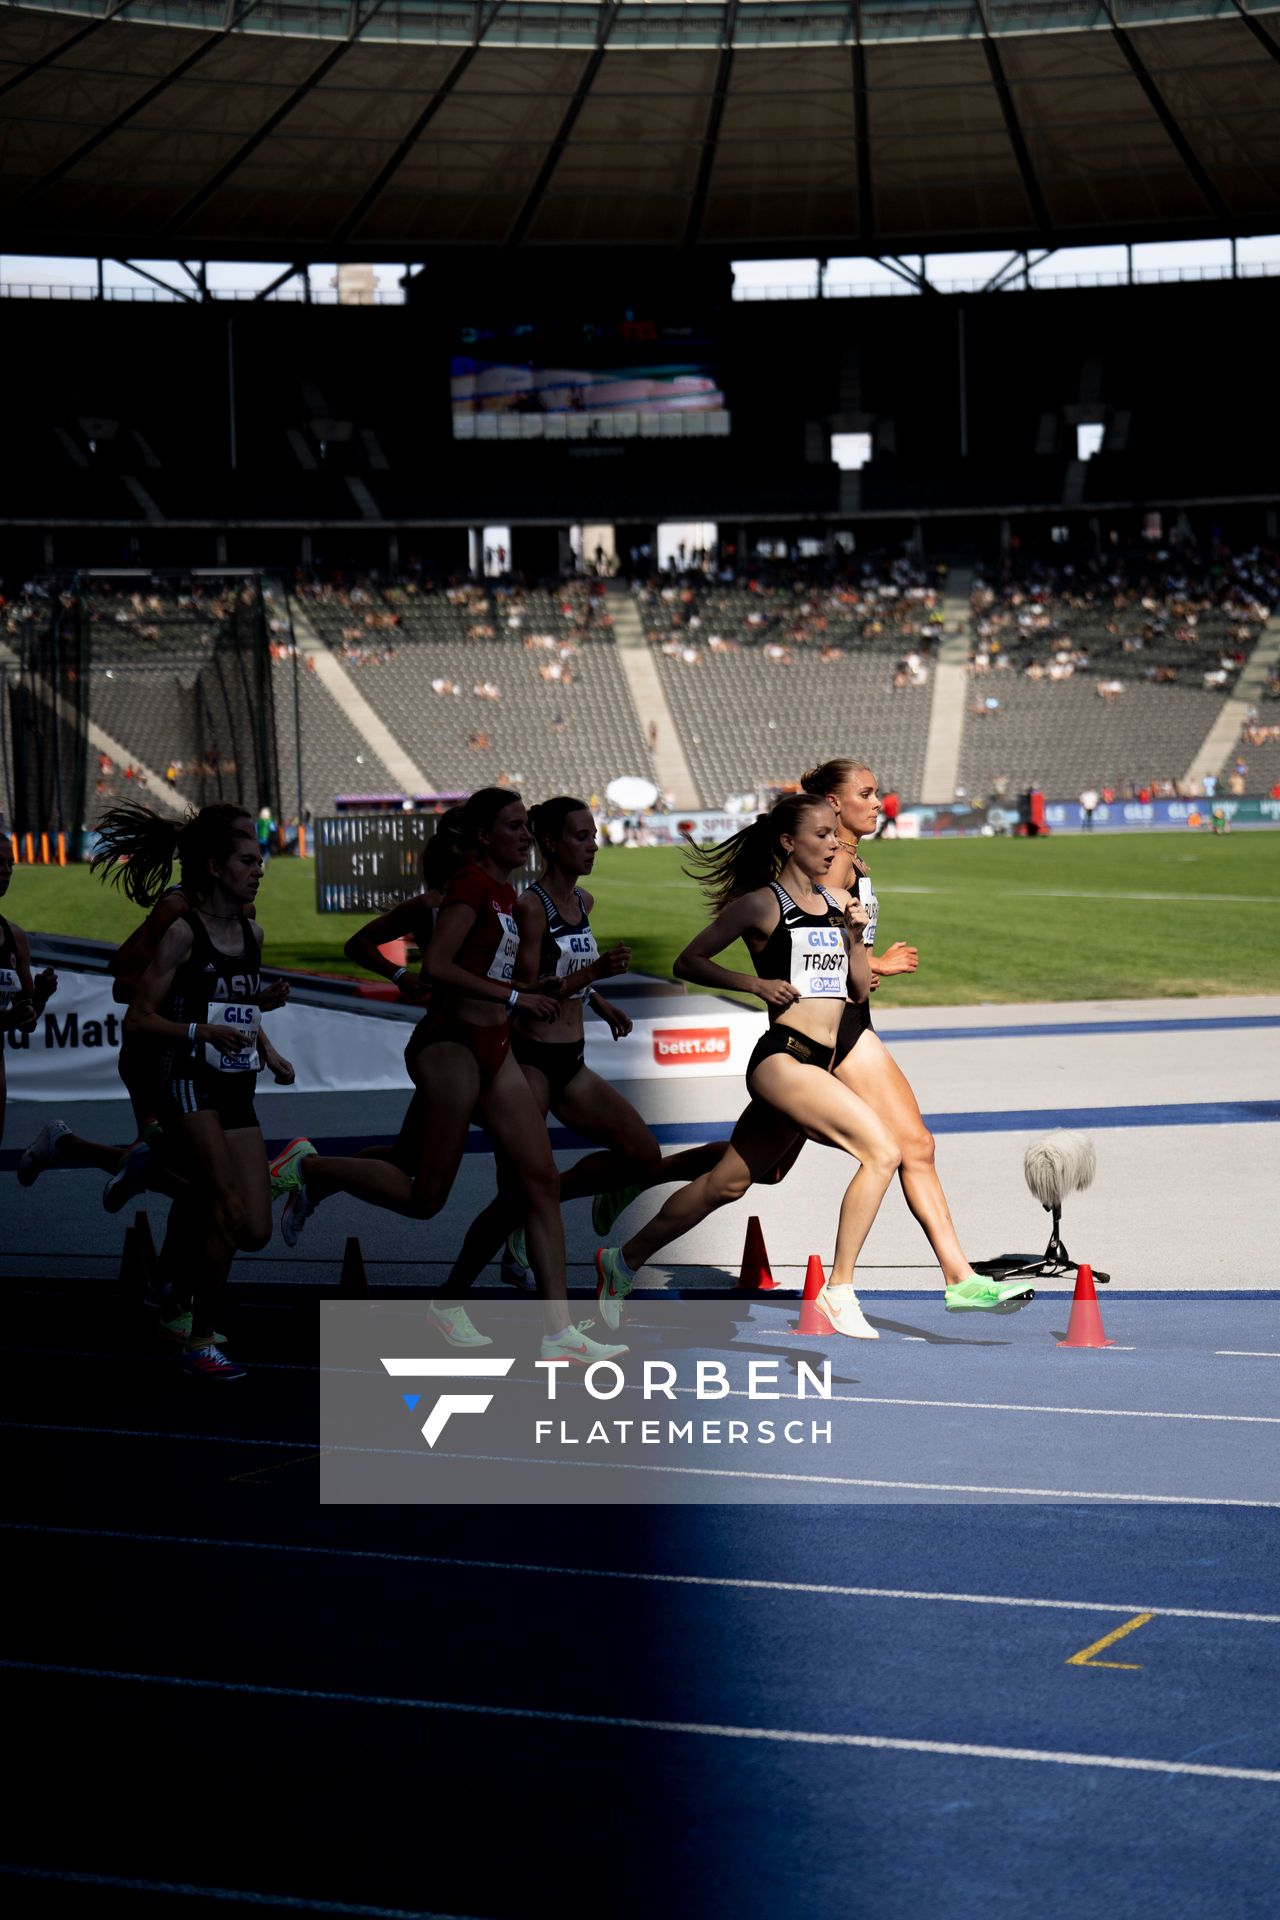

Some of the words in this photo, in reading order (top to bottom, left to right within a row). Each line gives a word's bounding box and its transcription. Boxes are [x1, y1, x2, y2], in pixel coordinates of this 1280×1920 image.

[803, 953, 845, 971] TROST
[45, 1012, 126, 1049] Mat
[658, 1038, 726, 1055] bett1.de
